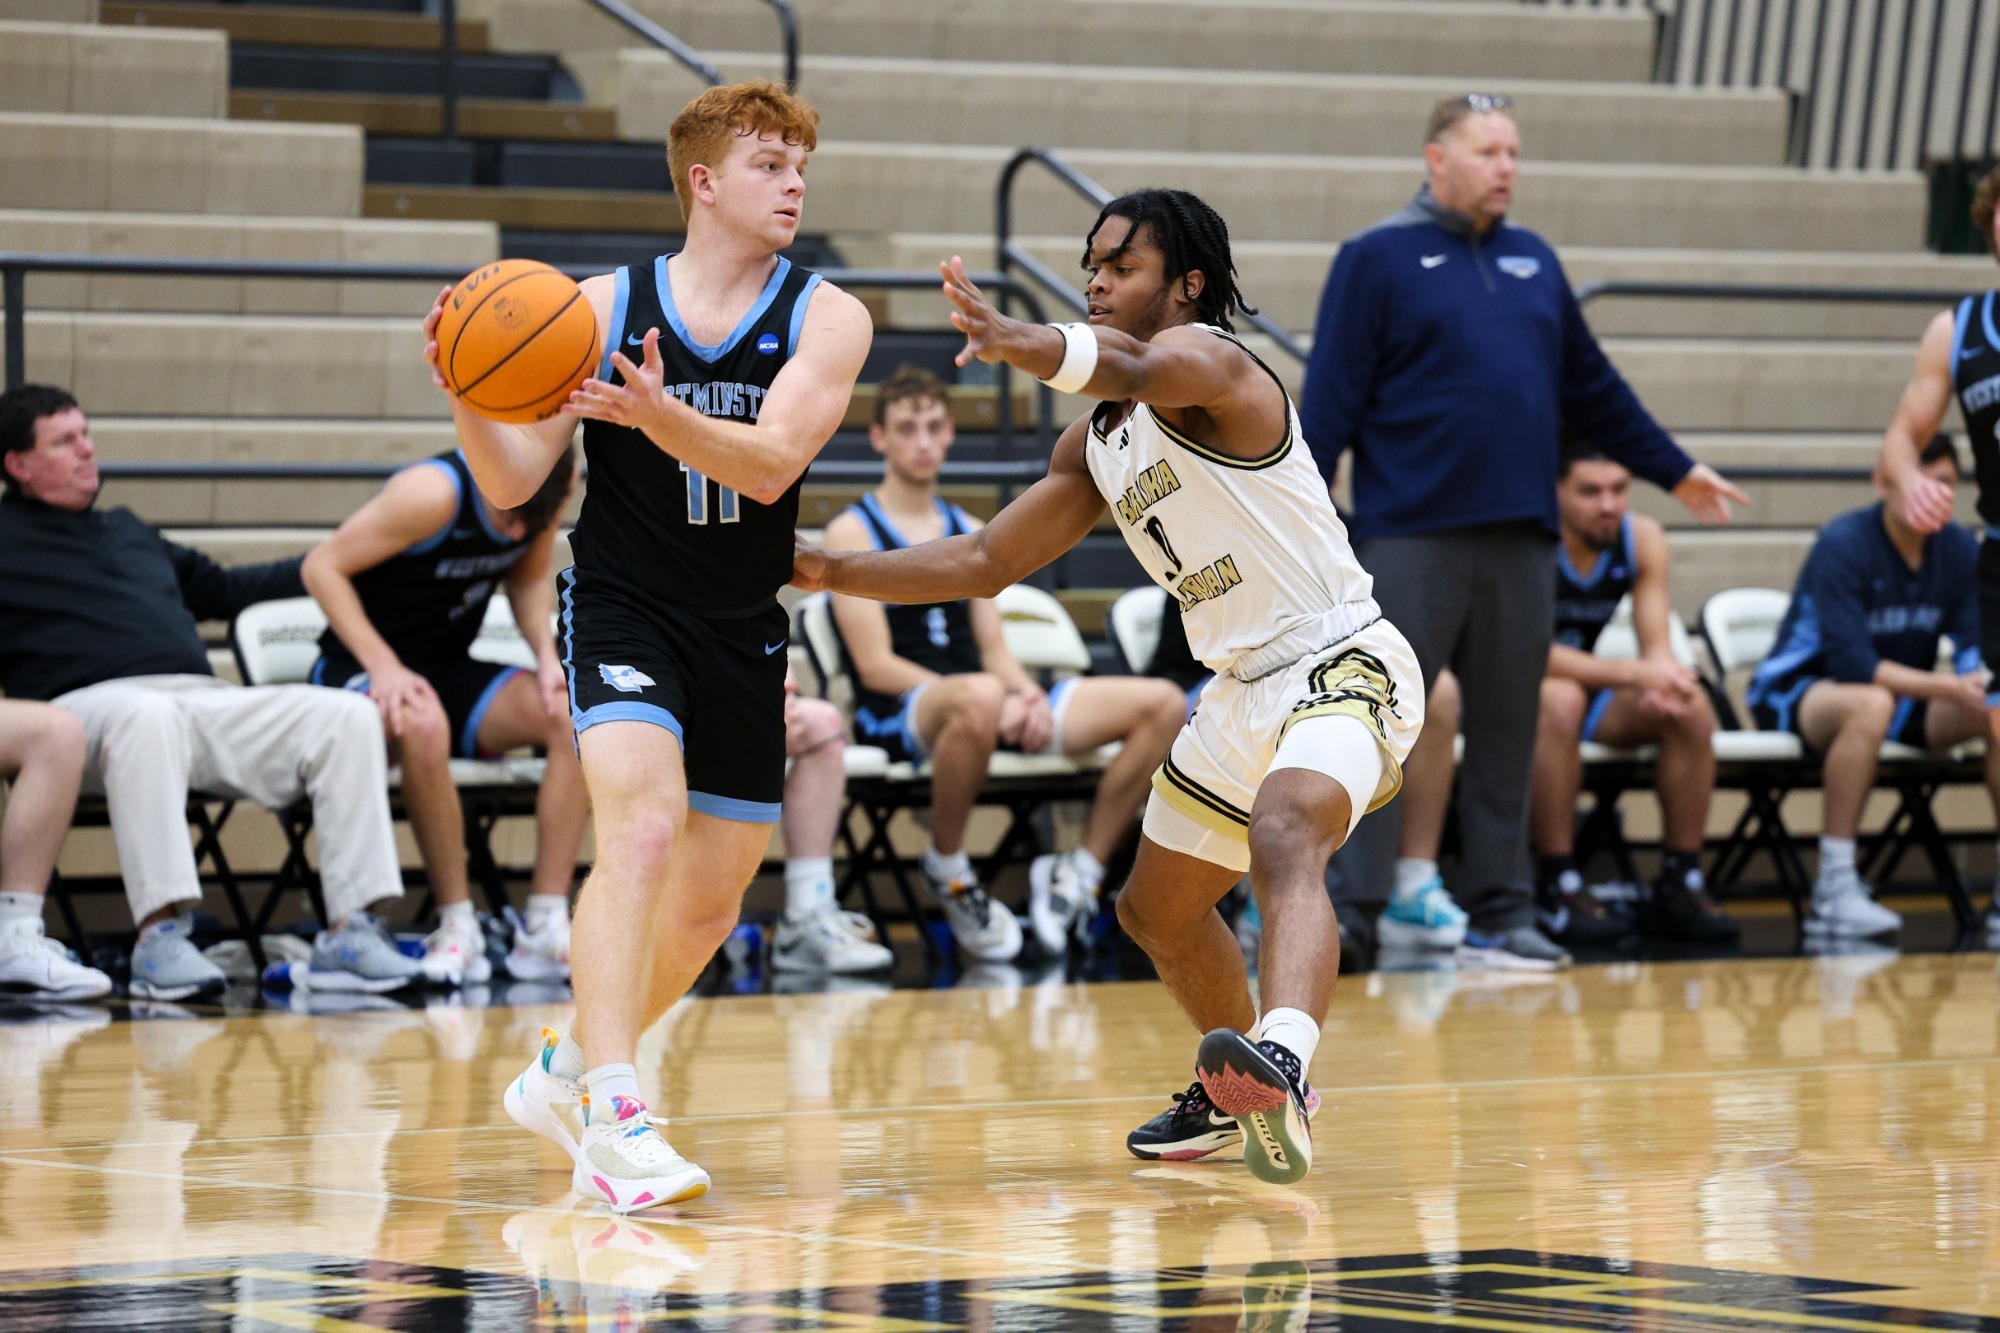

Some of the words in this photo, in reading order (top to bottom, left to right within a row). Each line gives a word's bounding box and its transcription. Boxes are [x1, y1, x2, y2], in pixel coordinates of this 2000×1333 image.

[759, 342, 779, 350] NCAA
[664, 381, 769, 419] TMINST
[1115, 458, 1182, 526] BRASKA
[1177, 553, 1243, 613] LEYAN
